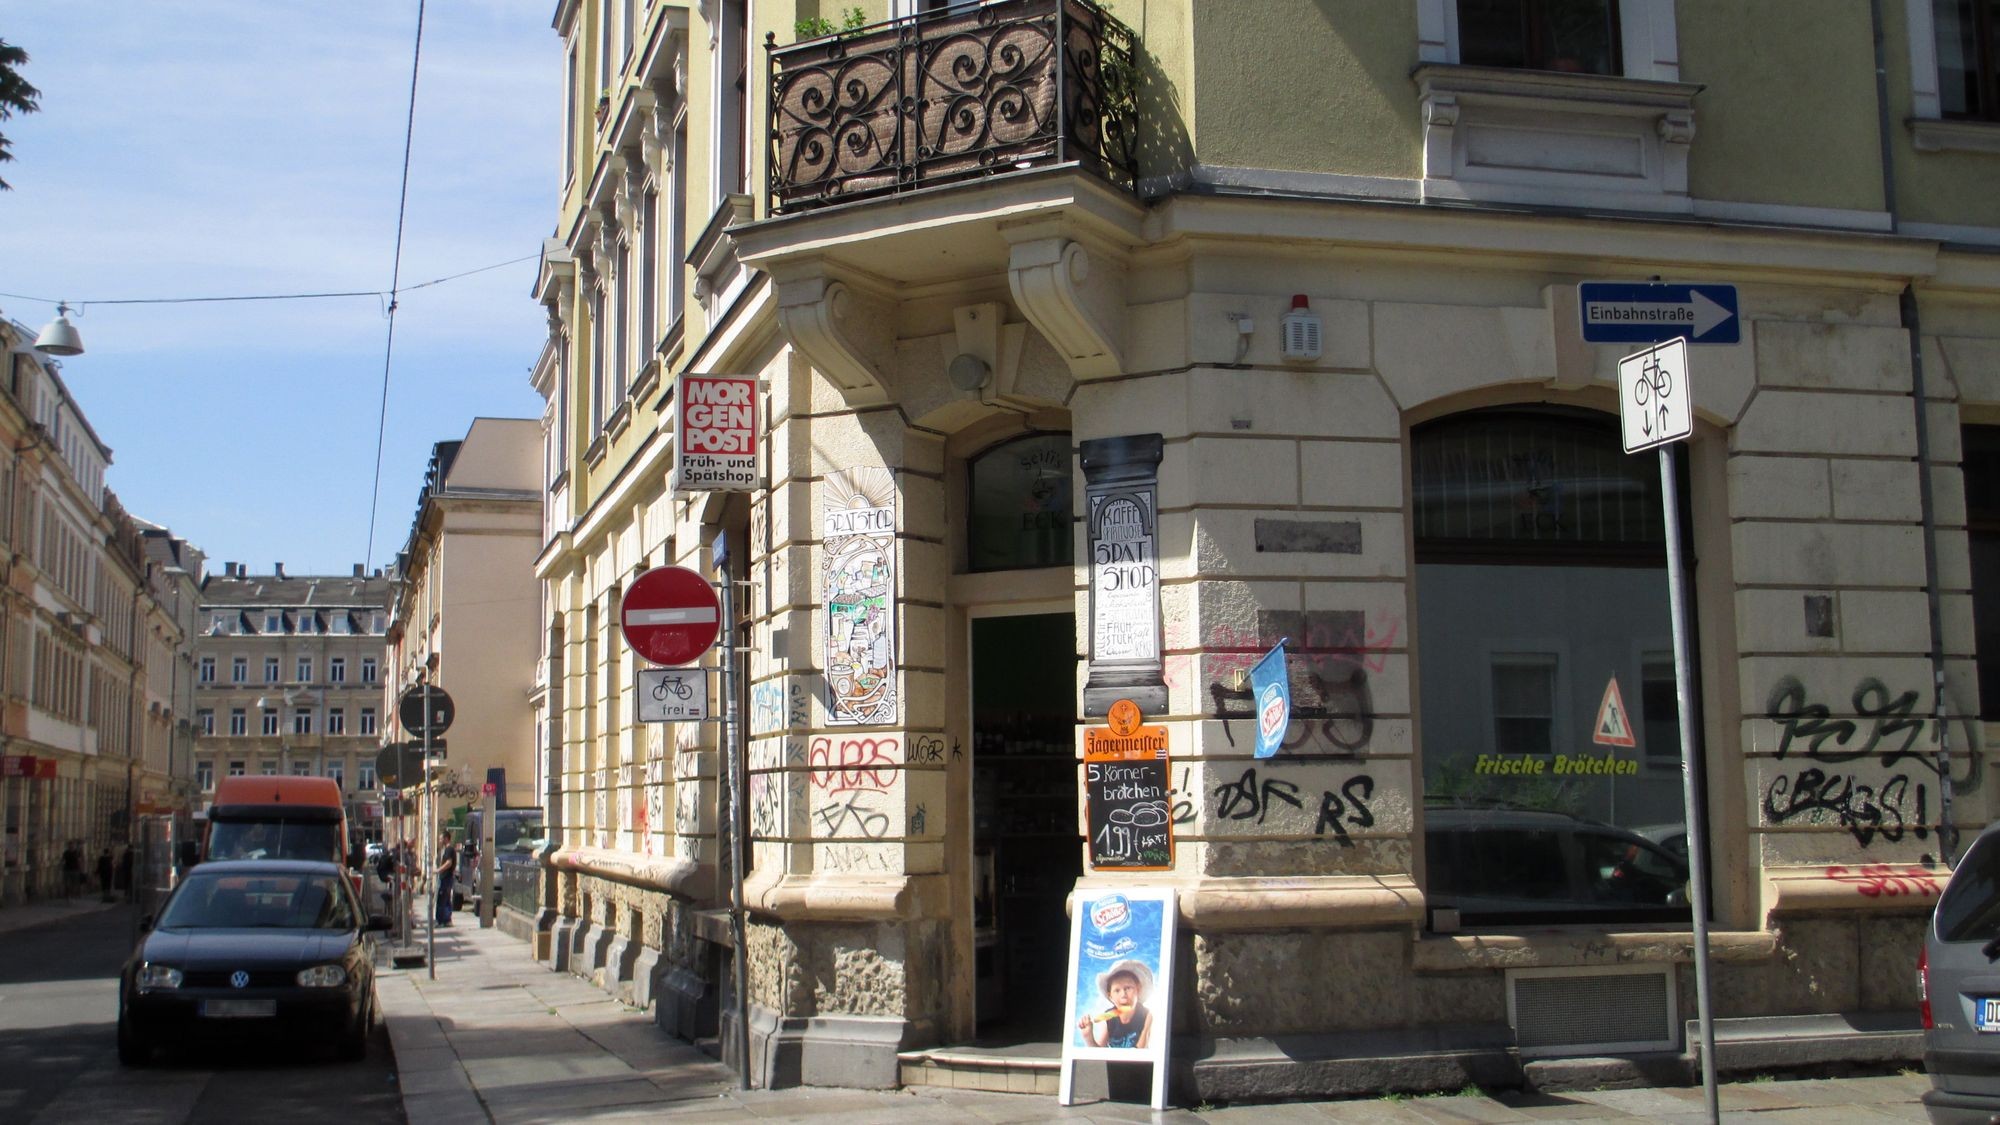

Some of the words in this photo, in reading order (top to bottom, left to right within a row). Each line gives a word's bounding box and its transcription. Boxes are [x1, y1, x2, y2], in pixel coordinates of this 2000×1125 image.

[1591, 305, 1694, 321] Einbahnstraße
[687, 381, 752, 406] MOR
[687, 404, 752, 429] GEN
[687, 428, 752, 452] POST
[682, 455, 722, 468] Früh-
[727, 456, 755, 469] und
[685, 469, 754, 485] Spätshop
[1103, 565, 1154, 591] SHOP
[663, 704, 684, 715] frei
[1088, 764, 1100, 782] 5
[1103, 763, 1156, 783] Körner-
[1474, 753, 1545, 775] Frische
[1553, 753, 1637, 775] Brötchen
[1103, 783, 1160, 801] brötchen
[1095, 823, 1131, 857] 1,99
